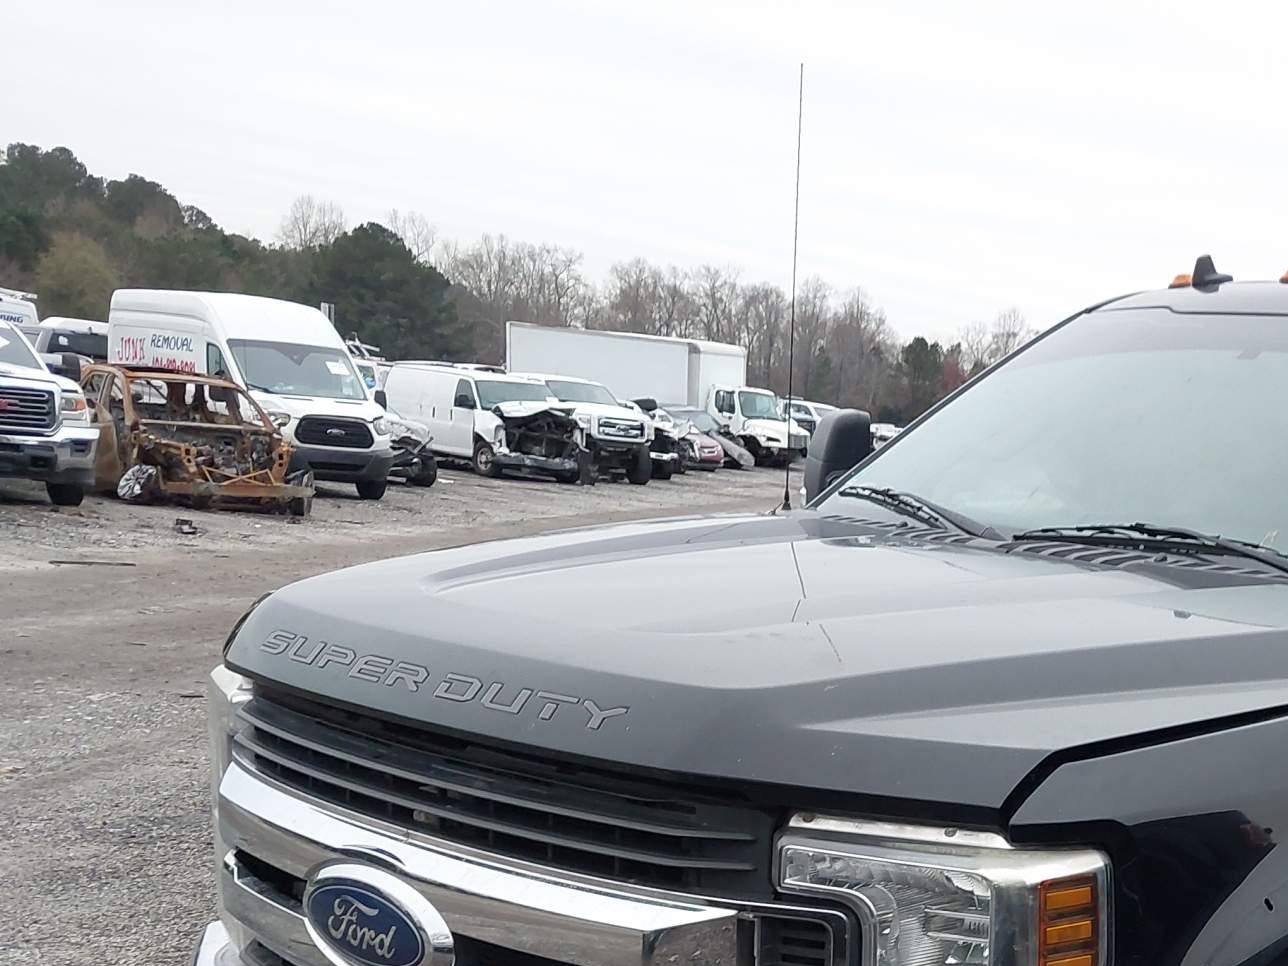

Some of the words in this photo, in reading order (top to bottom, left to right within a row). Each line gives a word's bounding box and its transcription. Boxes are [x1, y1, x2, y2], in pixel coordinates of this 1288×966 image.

[117, 336, 146, 361] JUNK
[150, 334, 194, 352] REMOVAL
[259, 629, 430, 692] SUPER
[433, 672, 631, 731] DUTY
[327, 894, 397, 959] Ford
